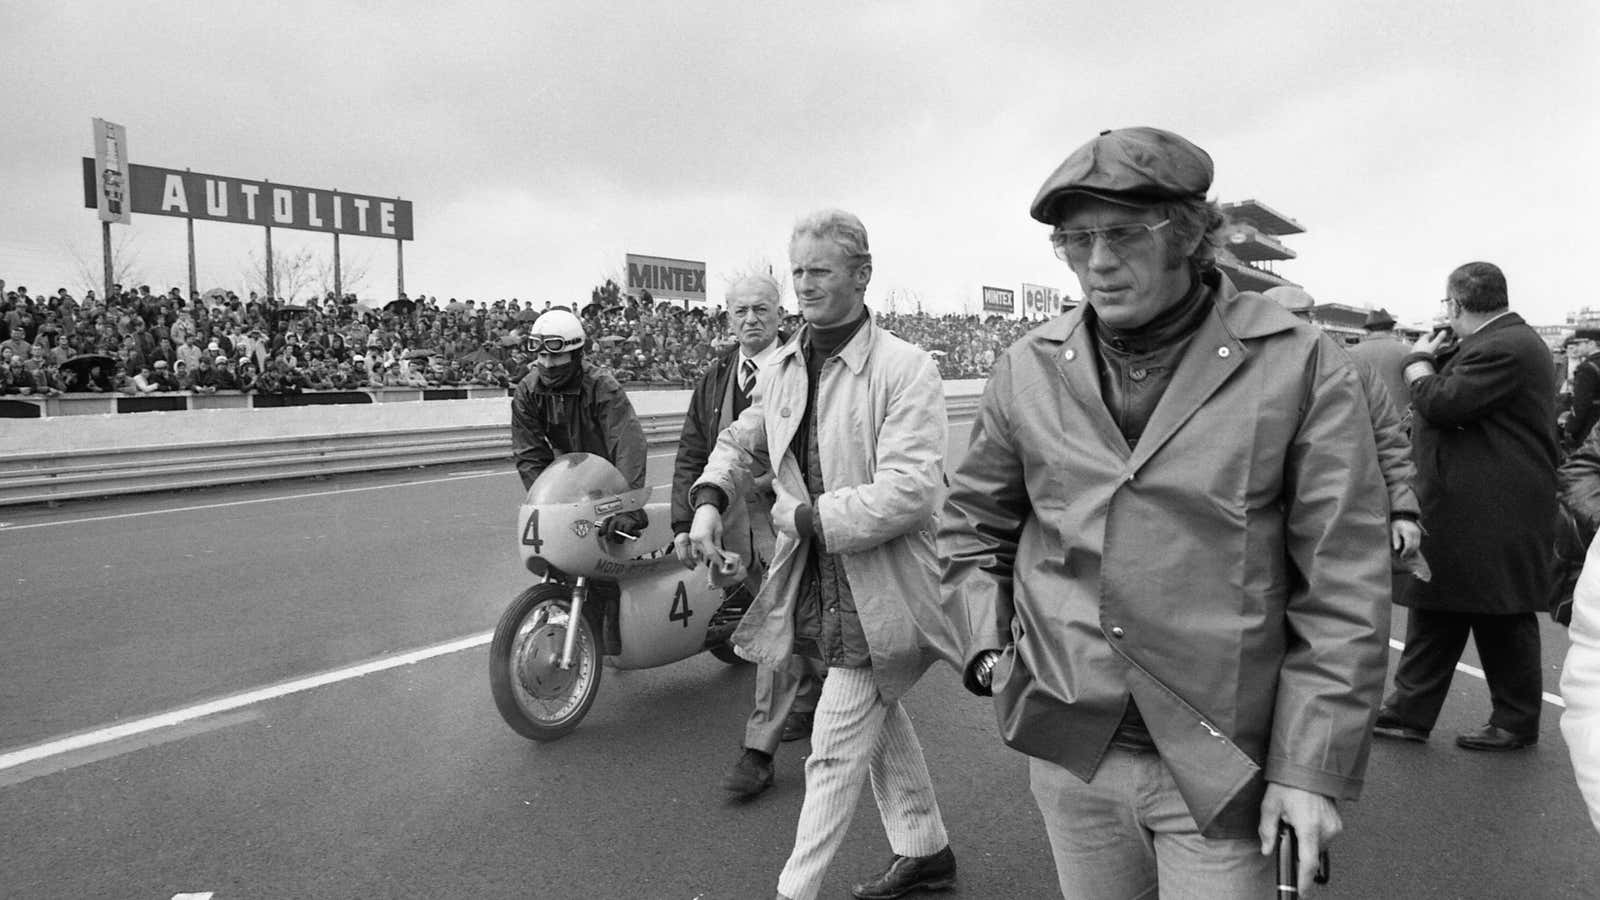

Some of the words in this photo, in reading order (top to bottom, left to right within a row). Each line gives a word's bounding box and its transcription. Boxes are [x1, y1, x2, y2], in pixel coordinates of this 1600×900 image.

[161, 174, 396, 235] AUTOLITE
[628, 262, 705, 293] MINTEX
[1034, 287, 1053, 313] elf
[522, 508, 544, 554] 4
[669, 580, 693, 628] 4
